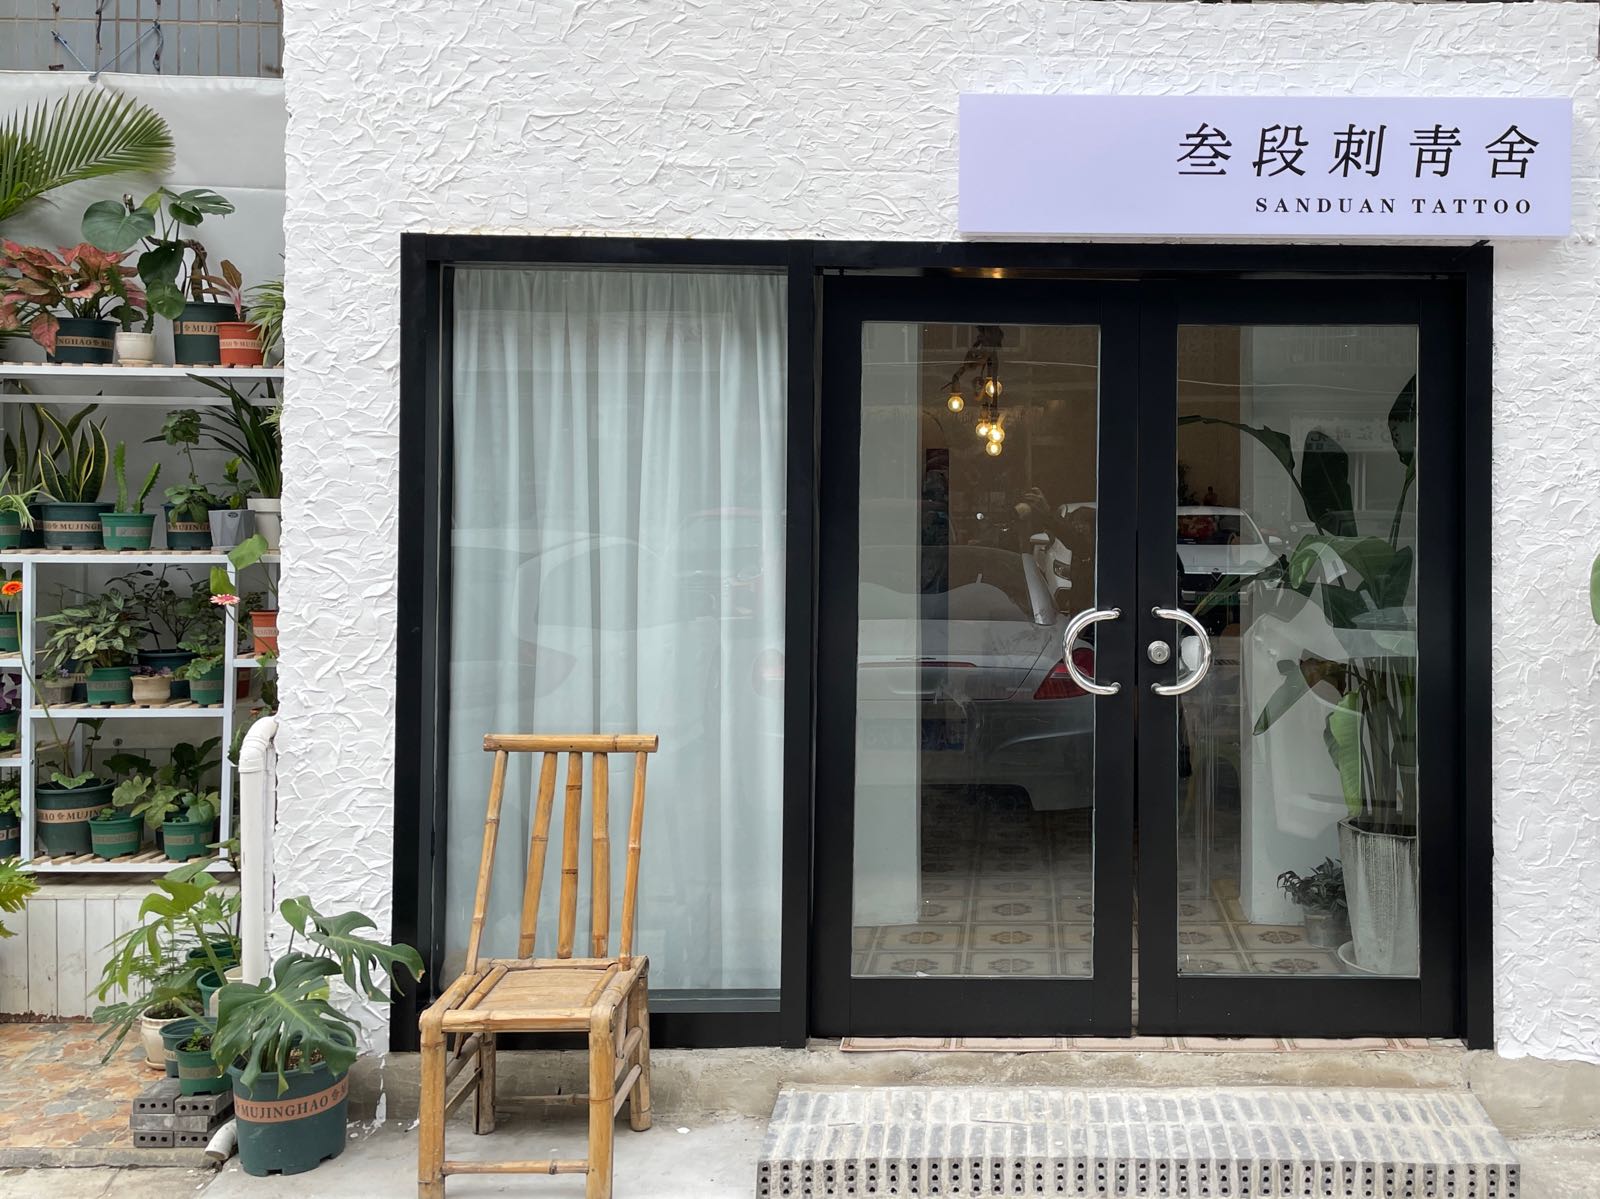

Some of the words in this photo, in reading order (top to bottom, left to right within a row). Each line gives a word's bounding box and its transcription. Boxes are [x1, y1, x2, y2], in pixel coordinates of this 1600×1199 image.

[1255, 197, 1396, 214] SANDUAN
[1411, 198, 1531, 214] TATTOO
[241, 1095, 328, 1119] MUJINGHAO
